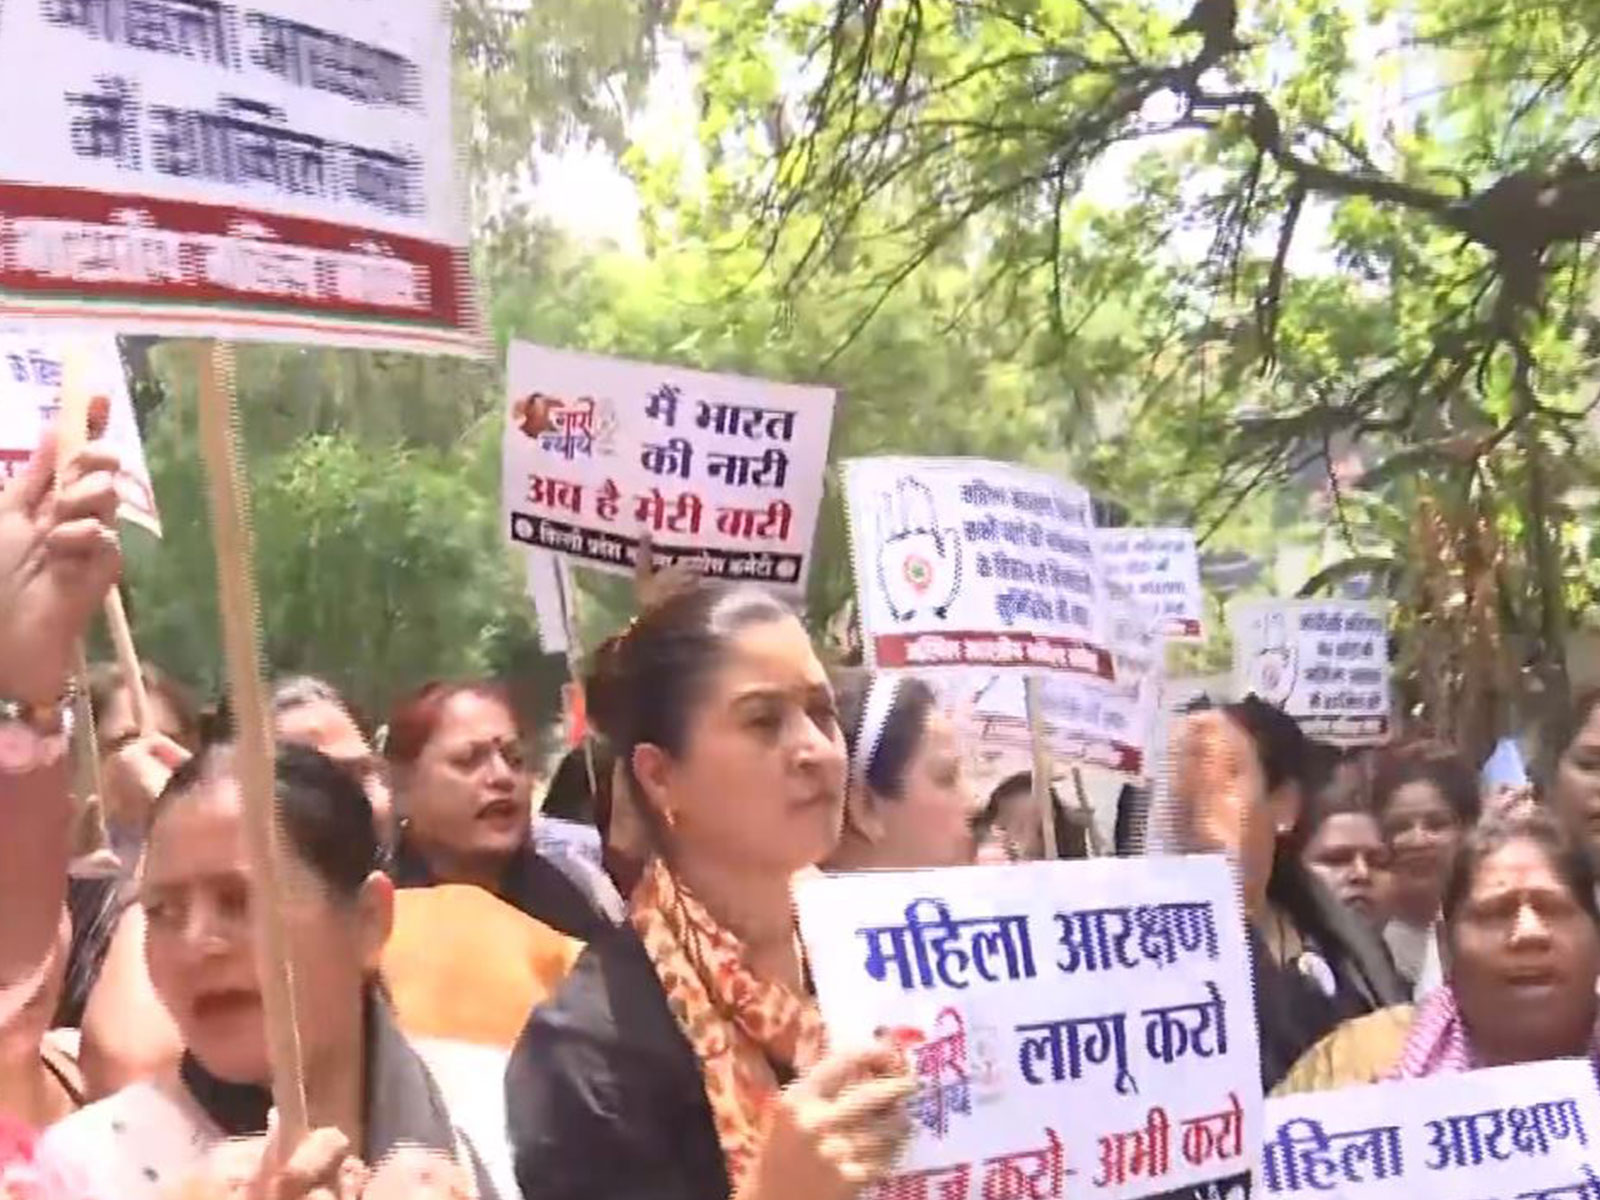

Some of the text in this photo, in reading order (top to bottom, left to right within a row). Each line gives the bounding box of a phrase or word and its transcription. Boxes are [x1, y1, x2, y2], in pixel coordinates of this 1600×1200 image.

[645, 384, 797, 442] मैं भारत
[641, 438, 789, 488] की नारी
[596, 478, 620, 521] है
[634, 488, 703, 534] मेरी
[855, 897, 1220, 989] महिला आरक्षण
[1014, 981, 1228, 1096] लागू करो
[1093, 1106, 1170, 1187] अभी
[1180, 1091, 1244, 1166] करो
[1424, 1098, 1588, 1170] आरक्षण
